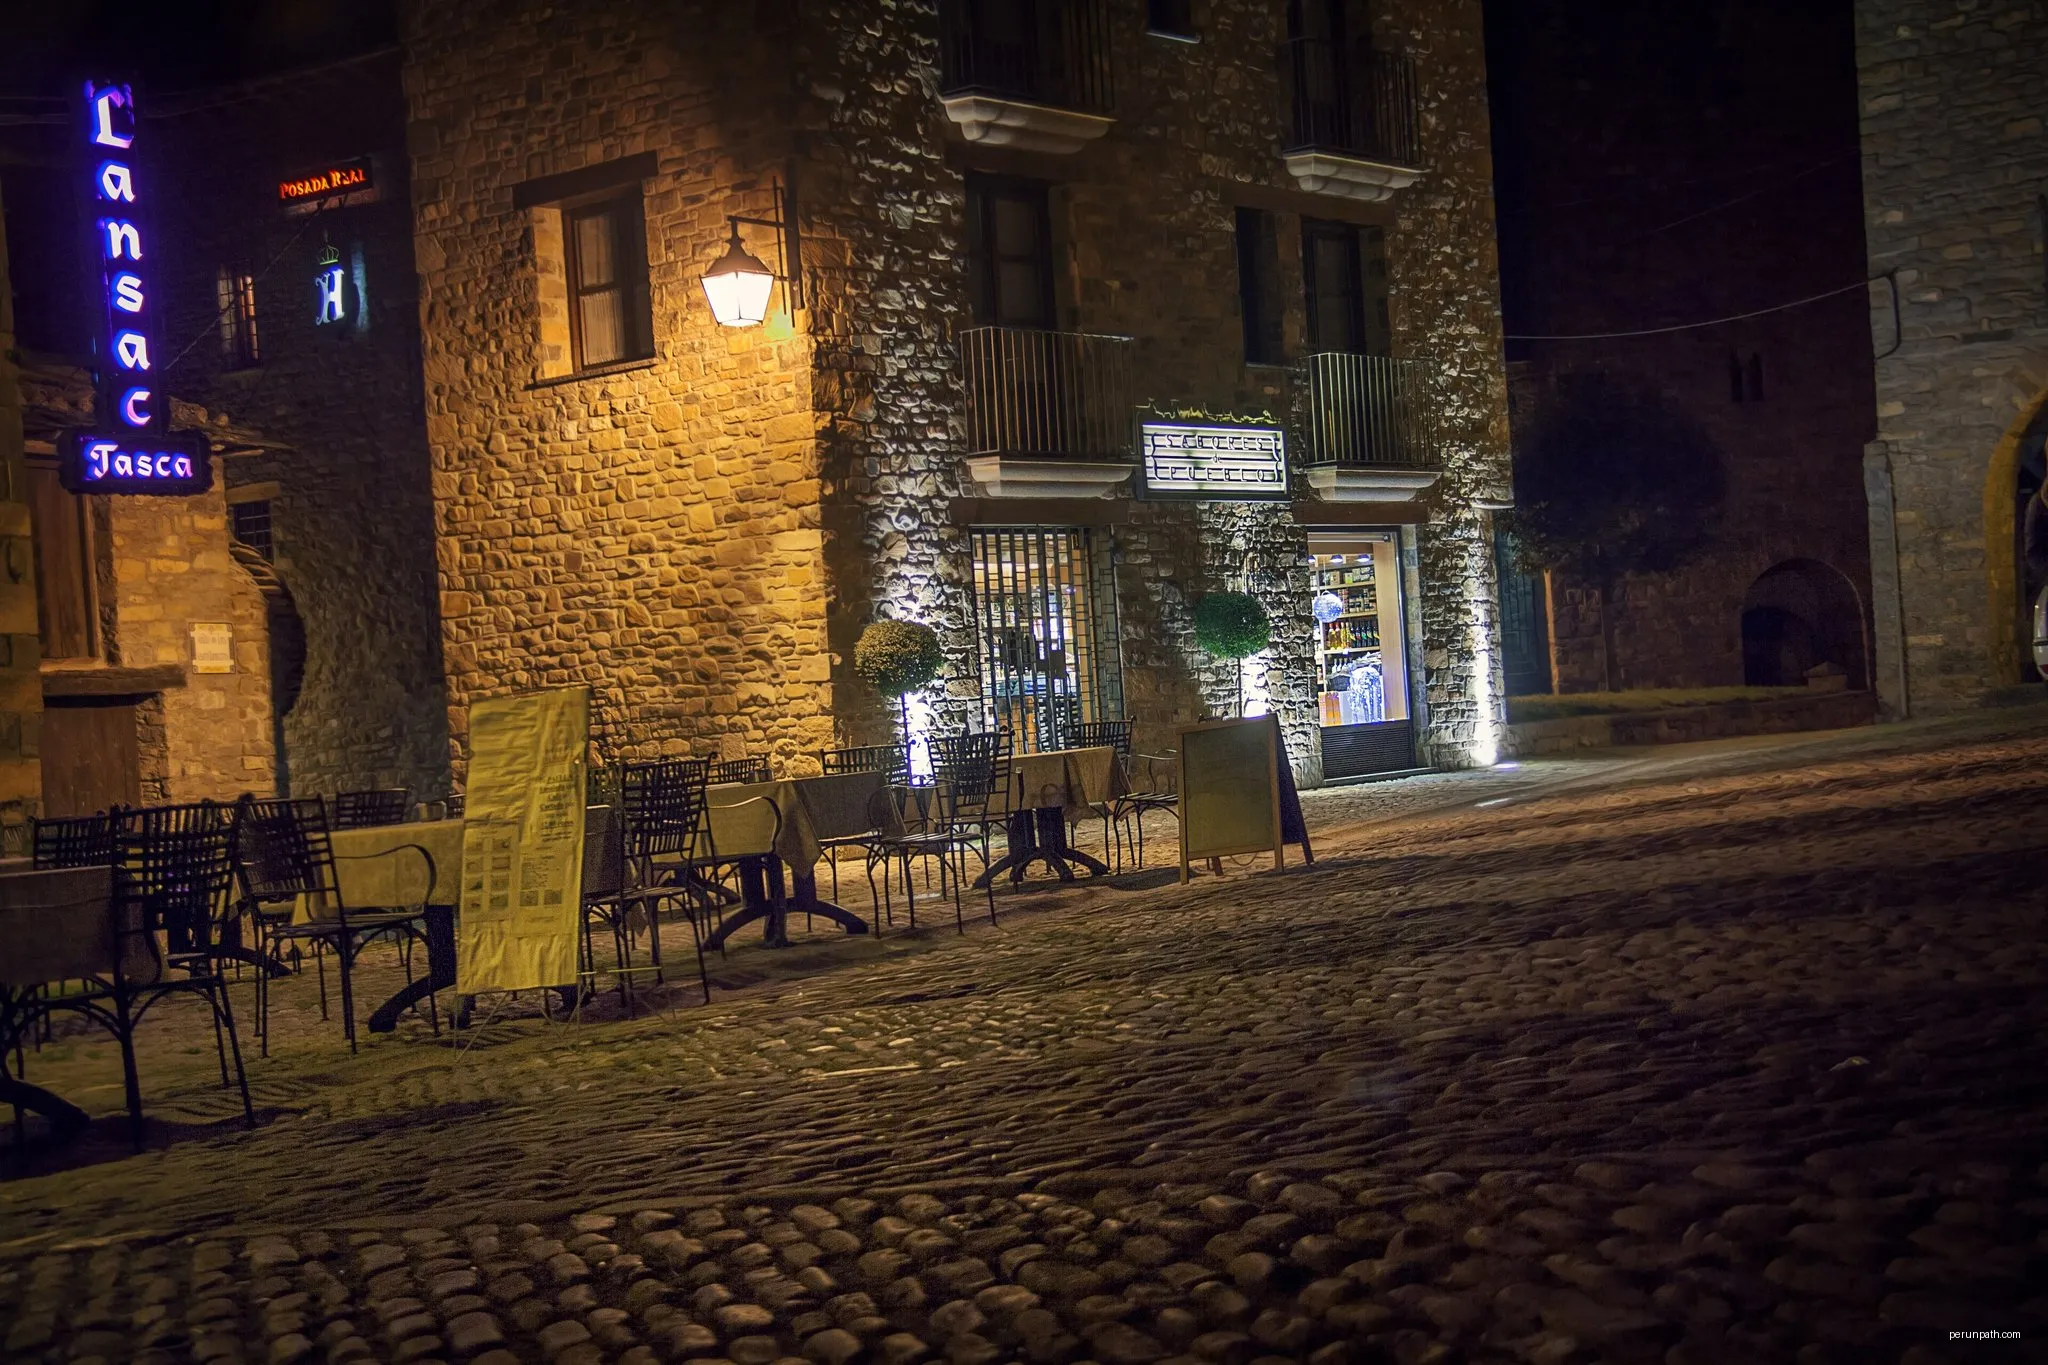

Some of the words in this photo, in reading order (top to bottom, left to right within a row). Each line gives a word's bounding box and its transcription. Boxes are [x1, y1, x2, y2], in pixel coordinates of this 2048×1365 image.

[279, 181, 331, 200] POSADA
[90, 82, 153, 427] Lansac
[1164, 434, 1264, 450] SABORES
[88, 444, 193, 479] Tasca
[1212, 454, 1223, 464] de
[1168, 465, 1265, 483] PUEBLO
